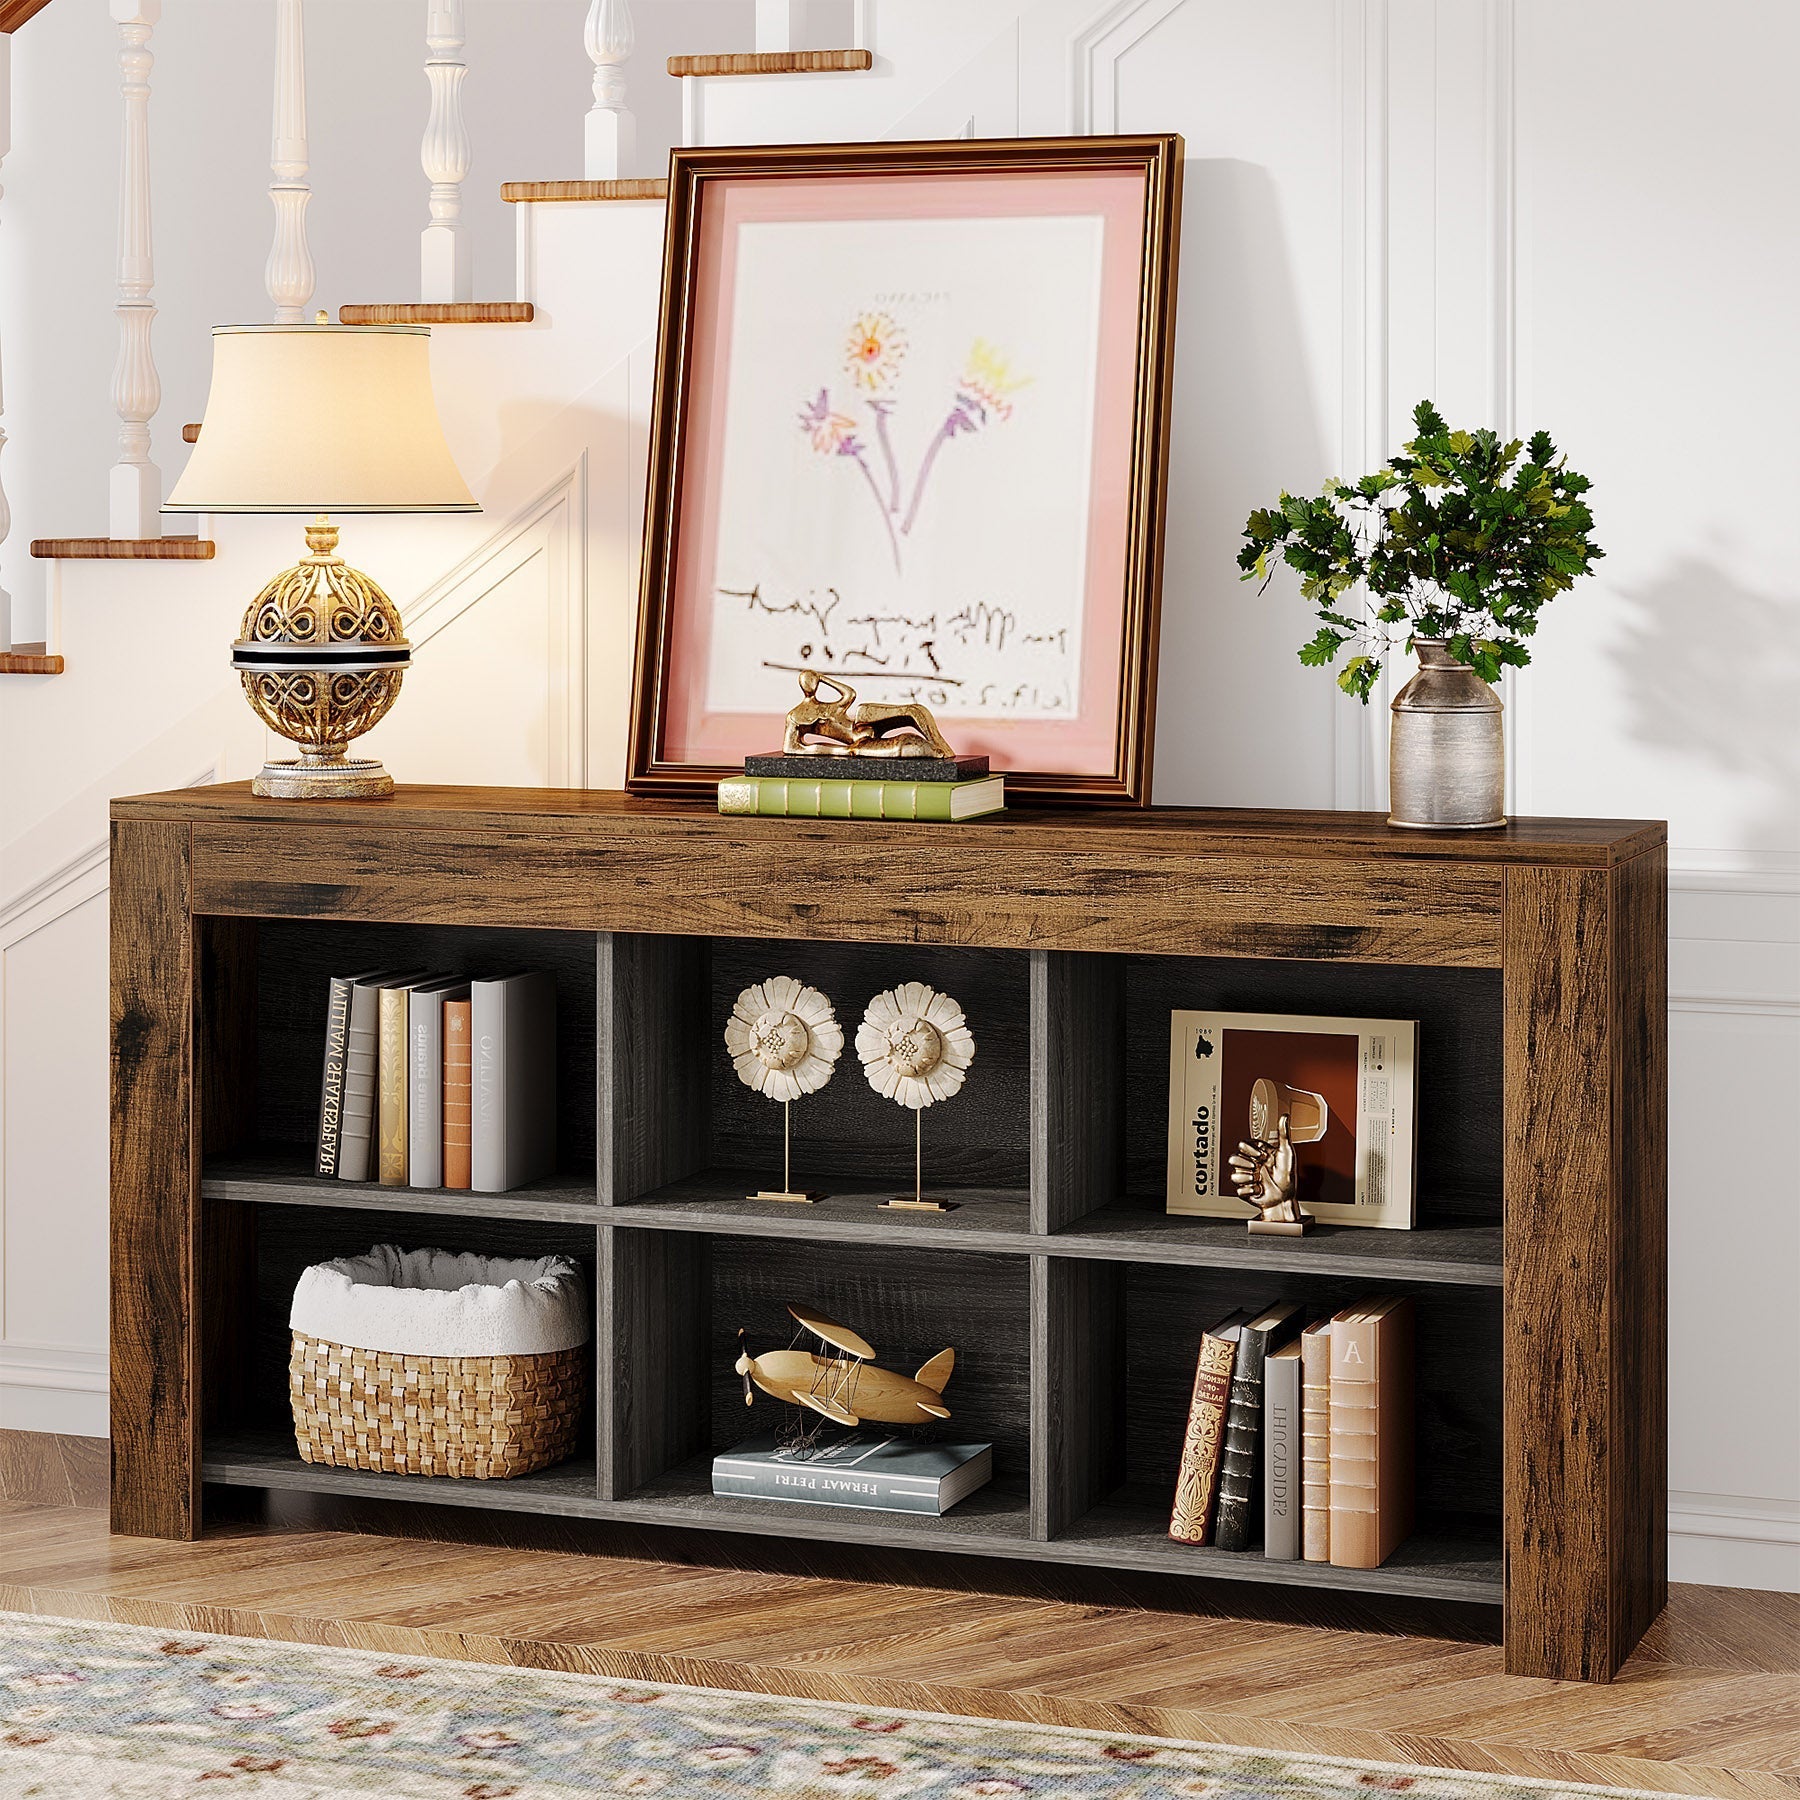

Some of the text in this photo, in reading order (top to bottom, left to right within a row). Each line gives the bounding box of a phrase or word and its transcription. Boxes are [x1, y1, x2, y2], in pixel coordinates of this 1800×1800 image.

[1191, 1105, 1210, 1196] cortado
[775, 1474, 878, 1495] FERMAT PETRI
